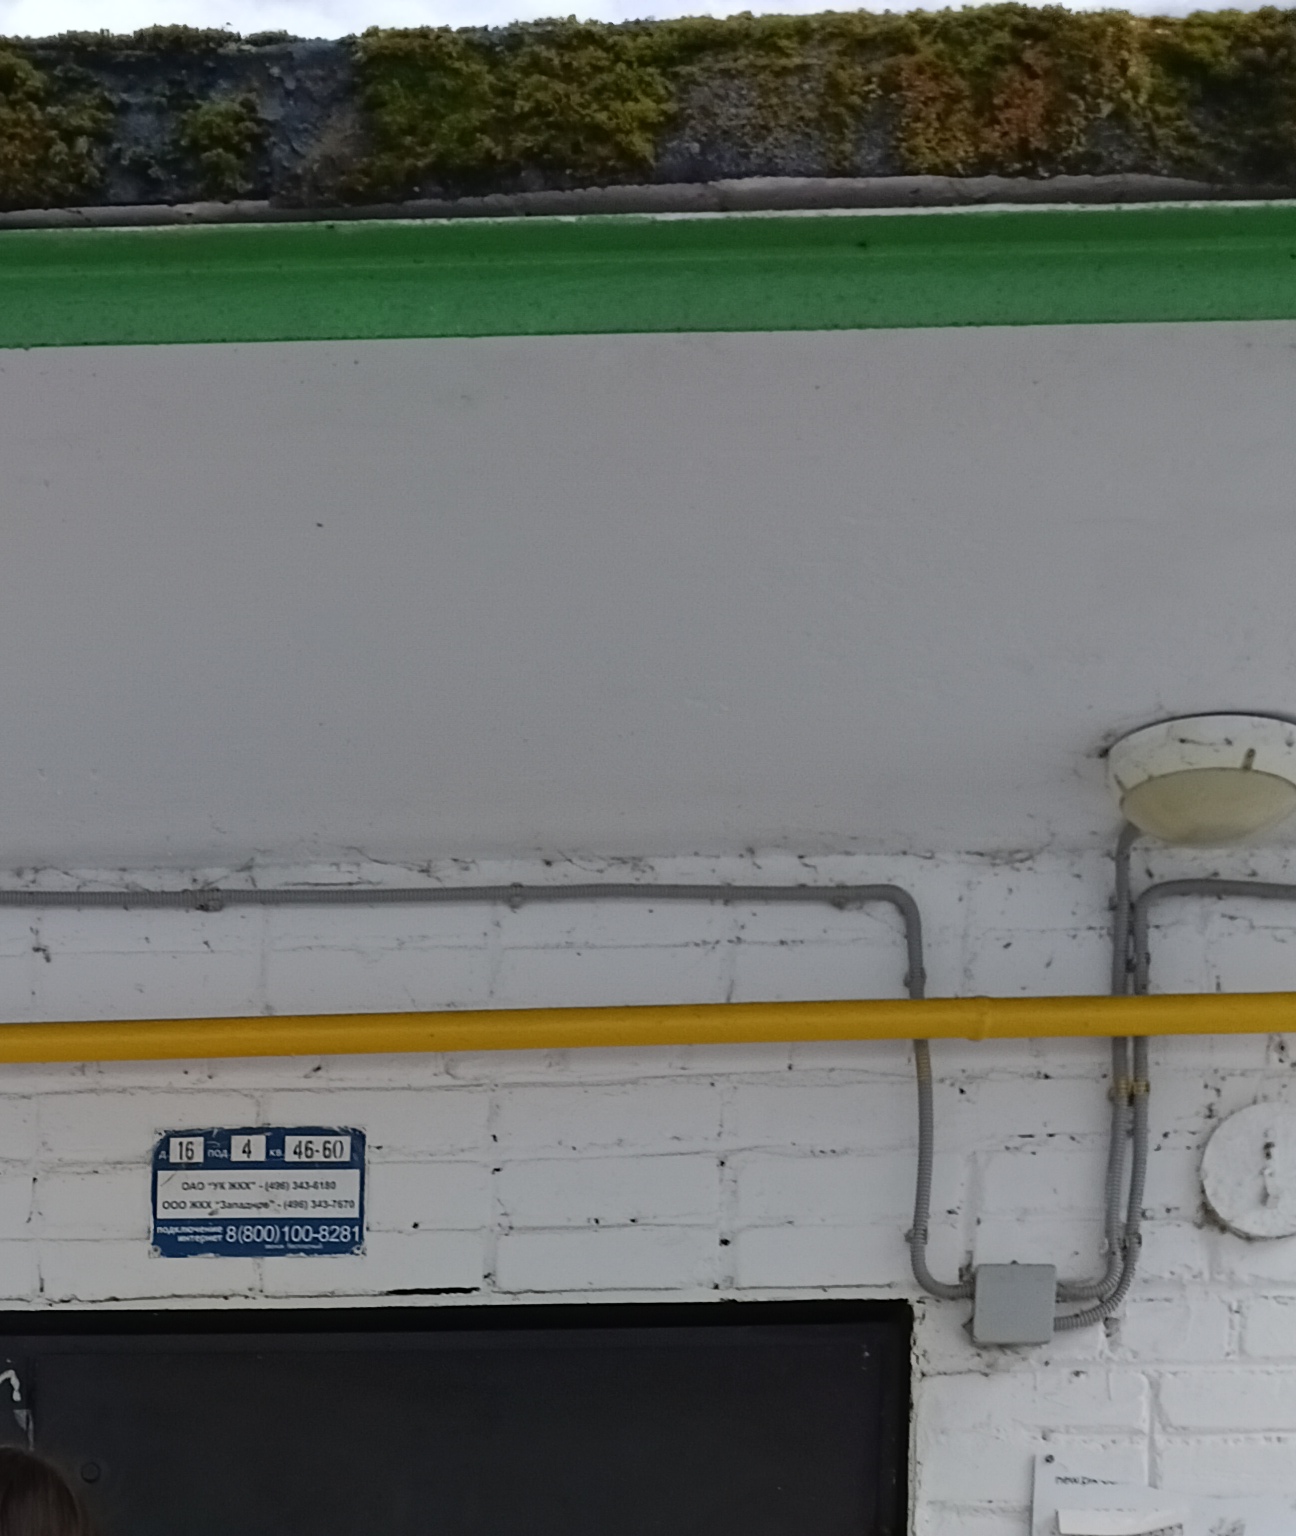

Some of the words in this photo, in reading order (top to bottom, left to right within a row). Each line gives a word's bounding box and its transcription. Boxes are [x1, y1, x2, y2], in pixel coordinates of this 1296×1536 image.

[178, 1141, 194, 1161] 16
[242, 1138, 252, 1159] 4
[293, 1140, 344, 1160] 46-60
[181, 1181, 205, 1191] ОАО
[162, 1200, 187, 1209] ООО
[225, 1225, 360, 1244] 8(800)100-8281
